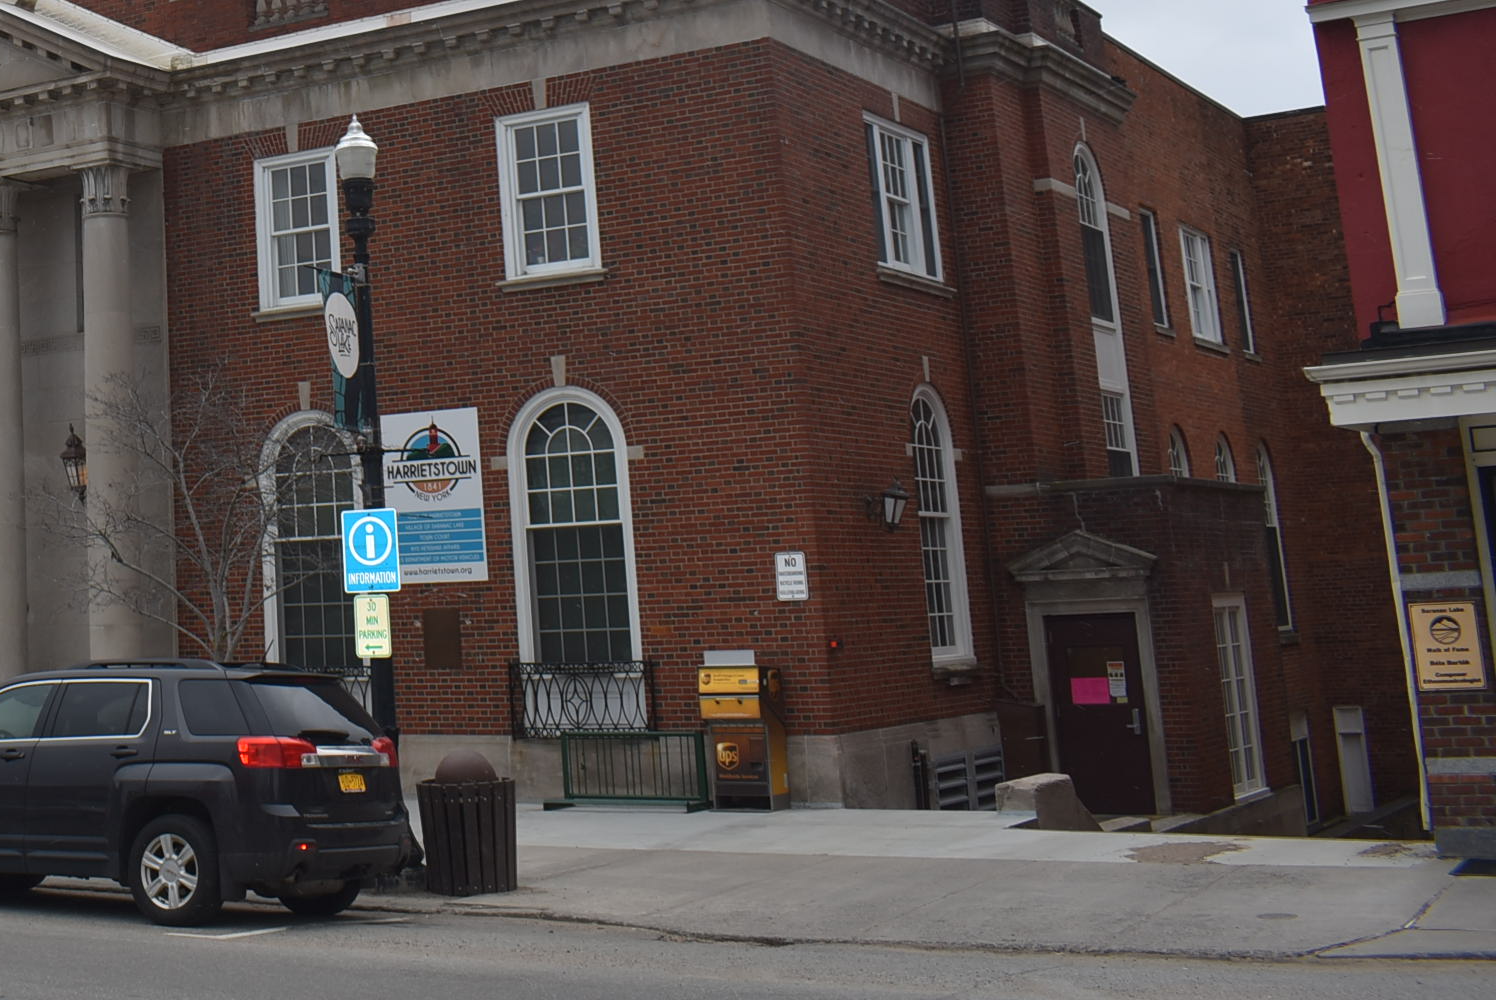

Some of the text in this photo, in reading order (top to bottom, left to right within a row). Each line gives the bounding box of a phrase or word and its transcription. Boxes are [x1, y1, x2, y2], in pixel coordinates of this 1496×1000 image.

[387, 460, 477, 479] HARRIETSTOWN
[423, 481, 441, 491] 1841
[415, 491, 452, 501] NEW YORK
[784, 557, 796, 567] NO
[404, 567, 472, 576] www.harrietstown.org
[348, 571, 396, 585] INFORMATION
[367, 602, 377, 612] 30
[366, 615, 378, 625] MIN
[358, 629, 387, 639] PARKING
[719, 750, 737, 766] ups
